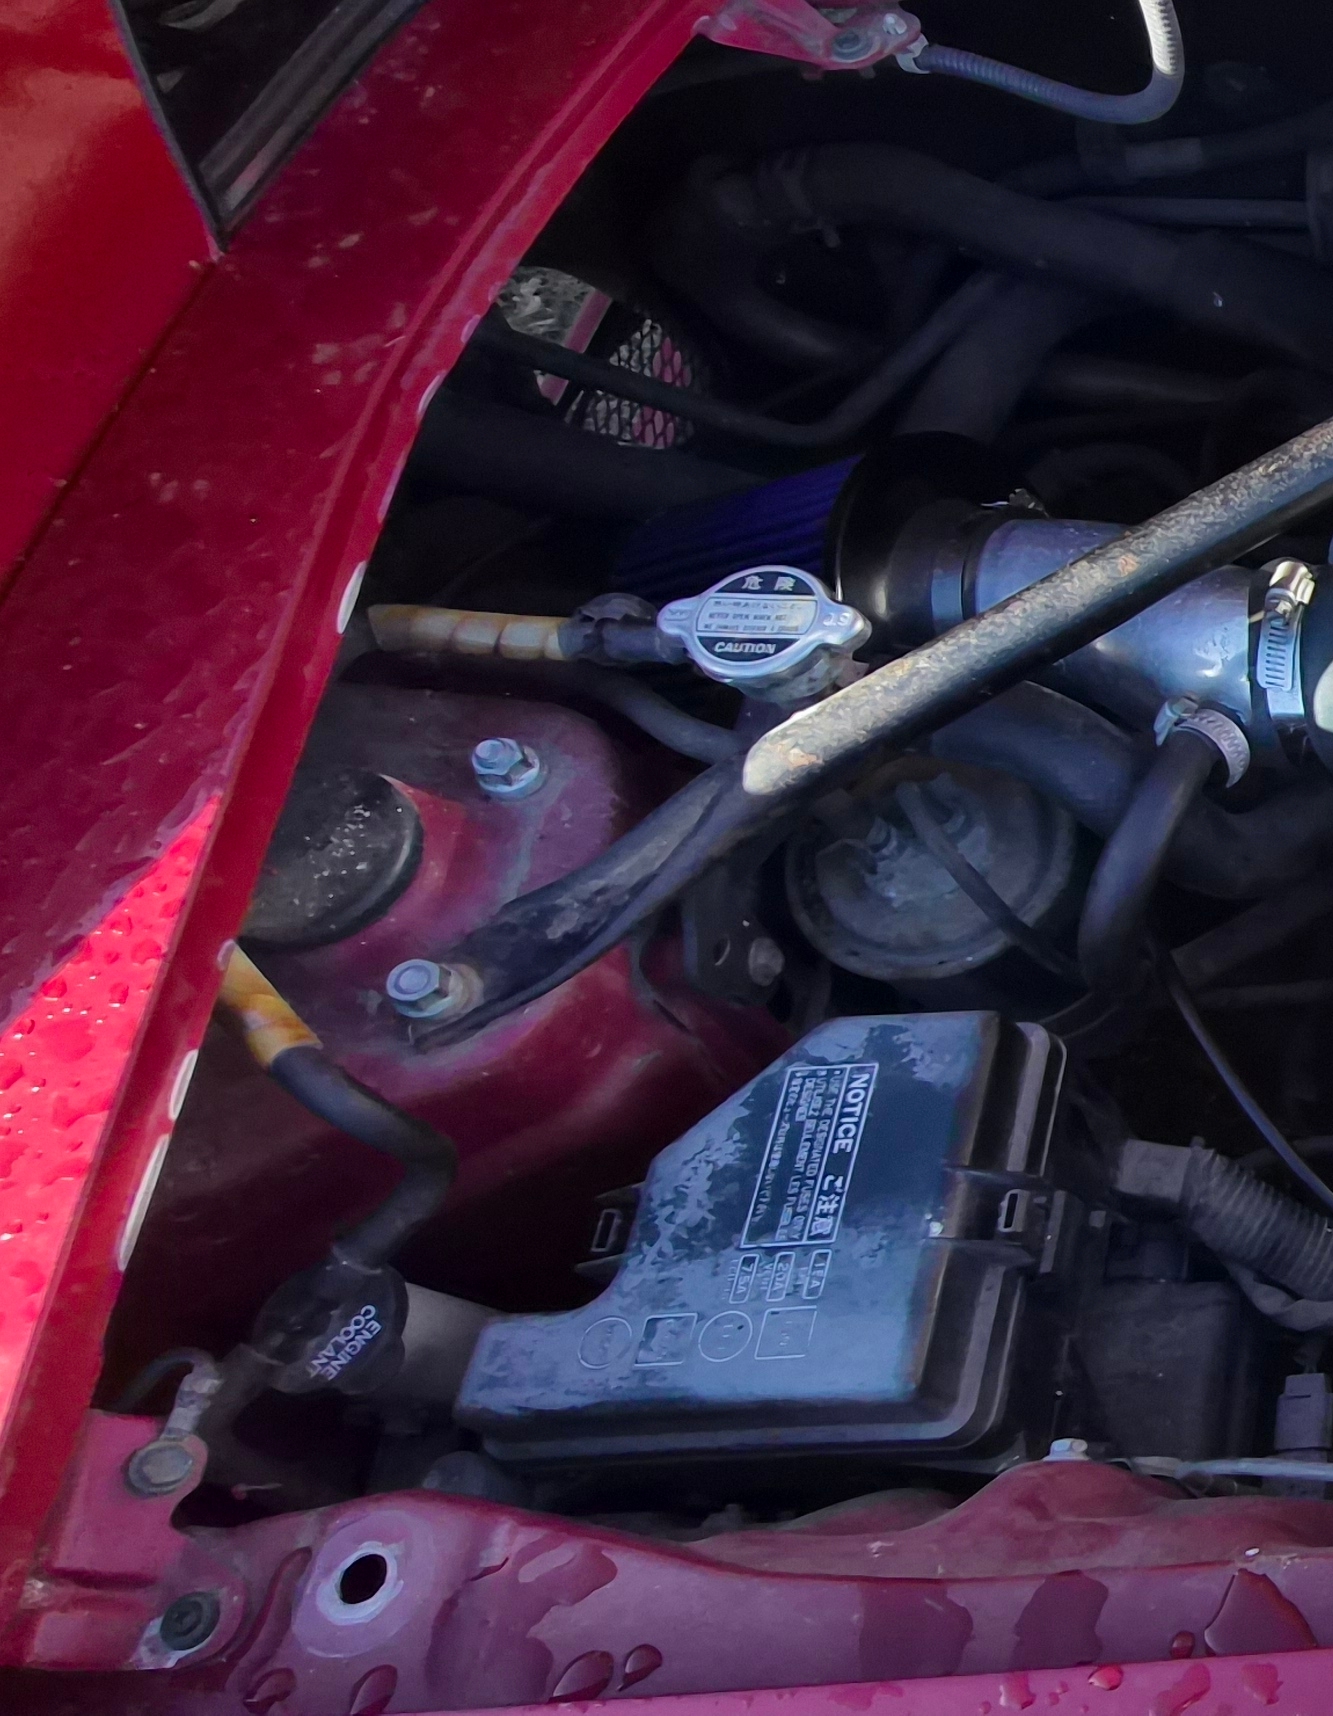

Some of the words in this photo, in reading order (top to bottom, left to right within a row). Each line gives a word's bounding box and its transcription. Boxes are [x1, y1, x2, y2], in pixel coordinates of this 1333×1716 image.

[713, 641, 777, 655] CAUTION
[831, 1073, 870, 1153] NOTICE
[796, 1179, 815, 1211] FUSES
[771, 1262, 790, 1292] 20A
[306, 1304, 377, 1379] COOLANT
[321, 1319, 382, 1381] ENGINE
